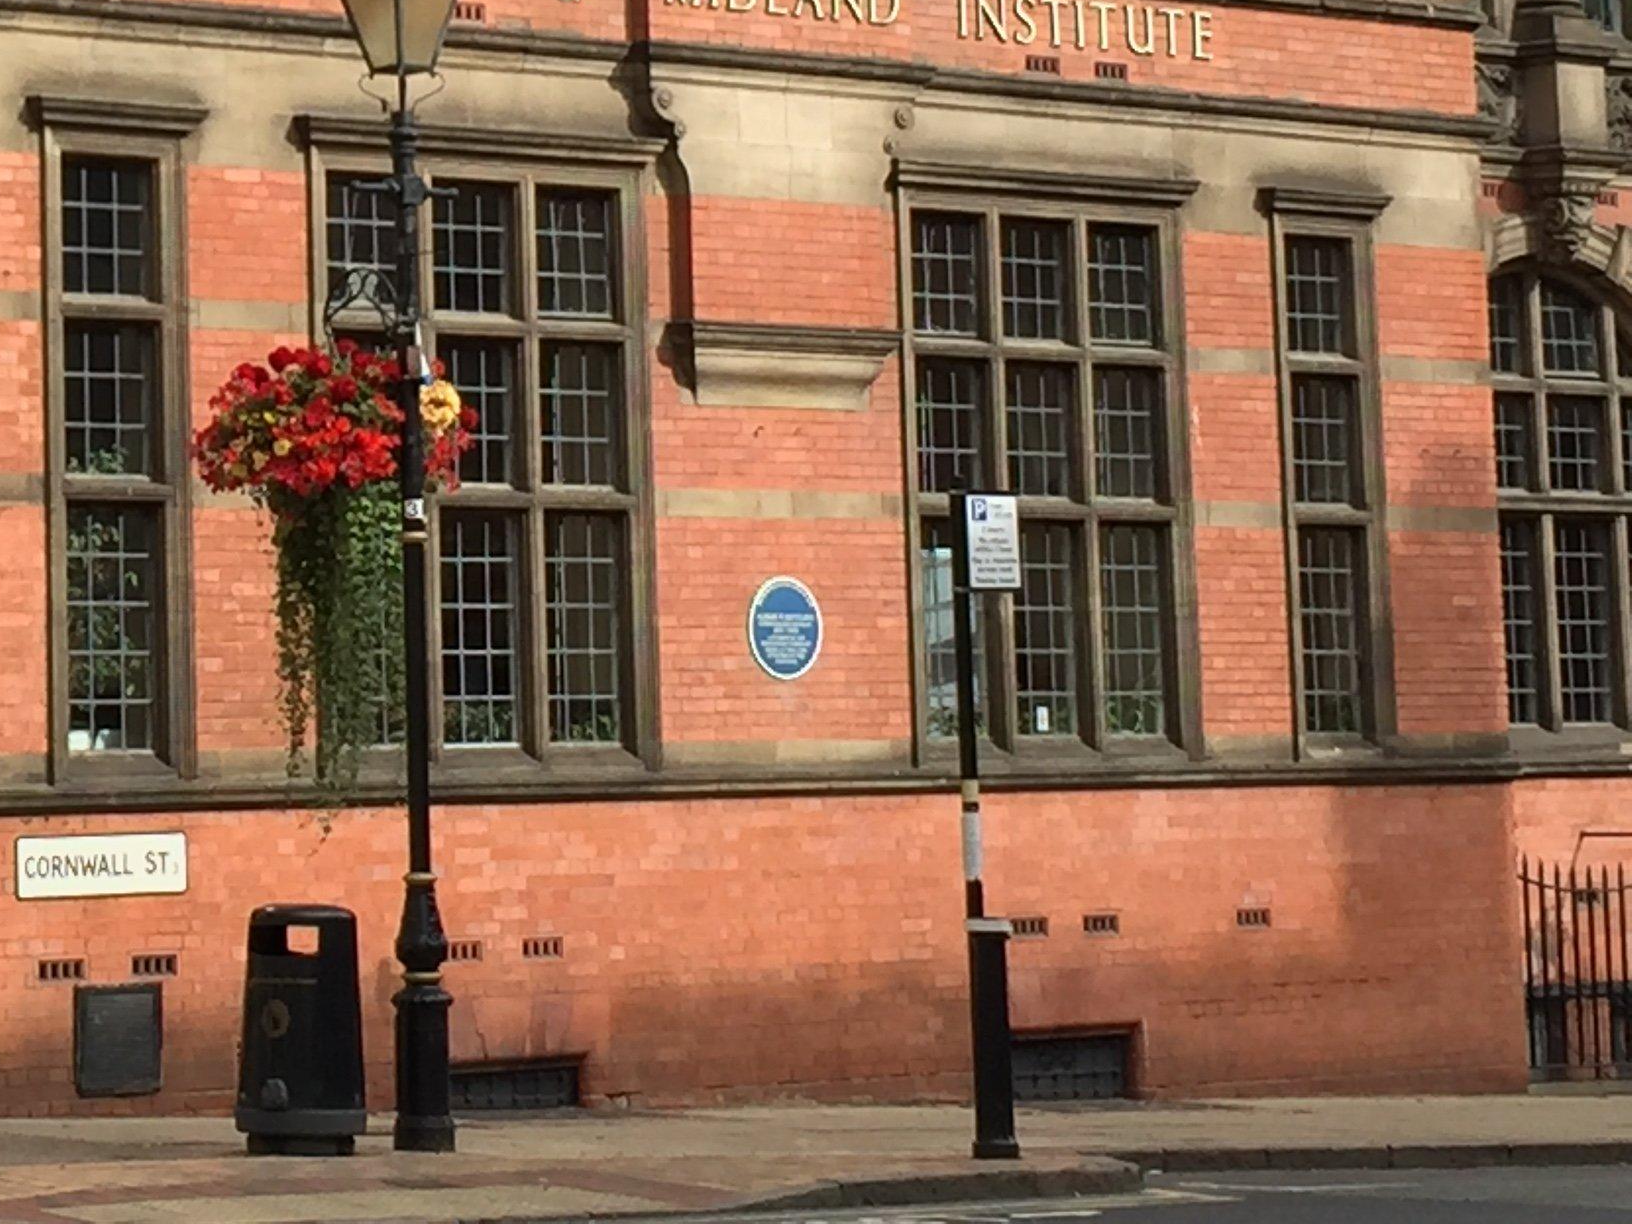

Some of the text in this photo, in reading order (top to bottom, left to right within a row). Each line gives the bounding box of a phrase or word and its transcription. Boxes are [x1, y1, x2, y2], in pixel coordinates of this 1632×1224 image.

[406, 501, 418, 517] 3
[24, 853, 133, 878] CORNWALL
[144, 850, 170, 875] ST
